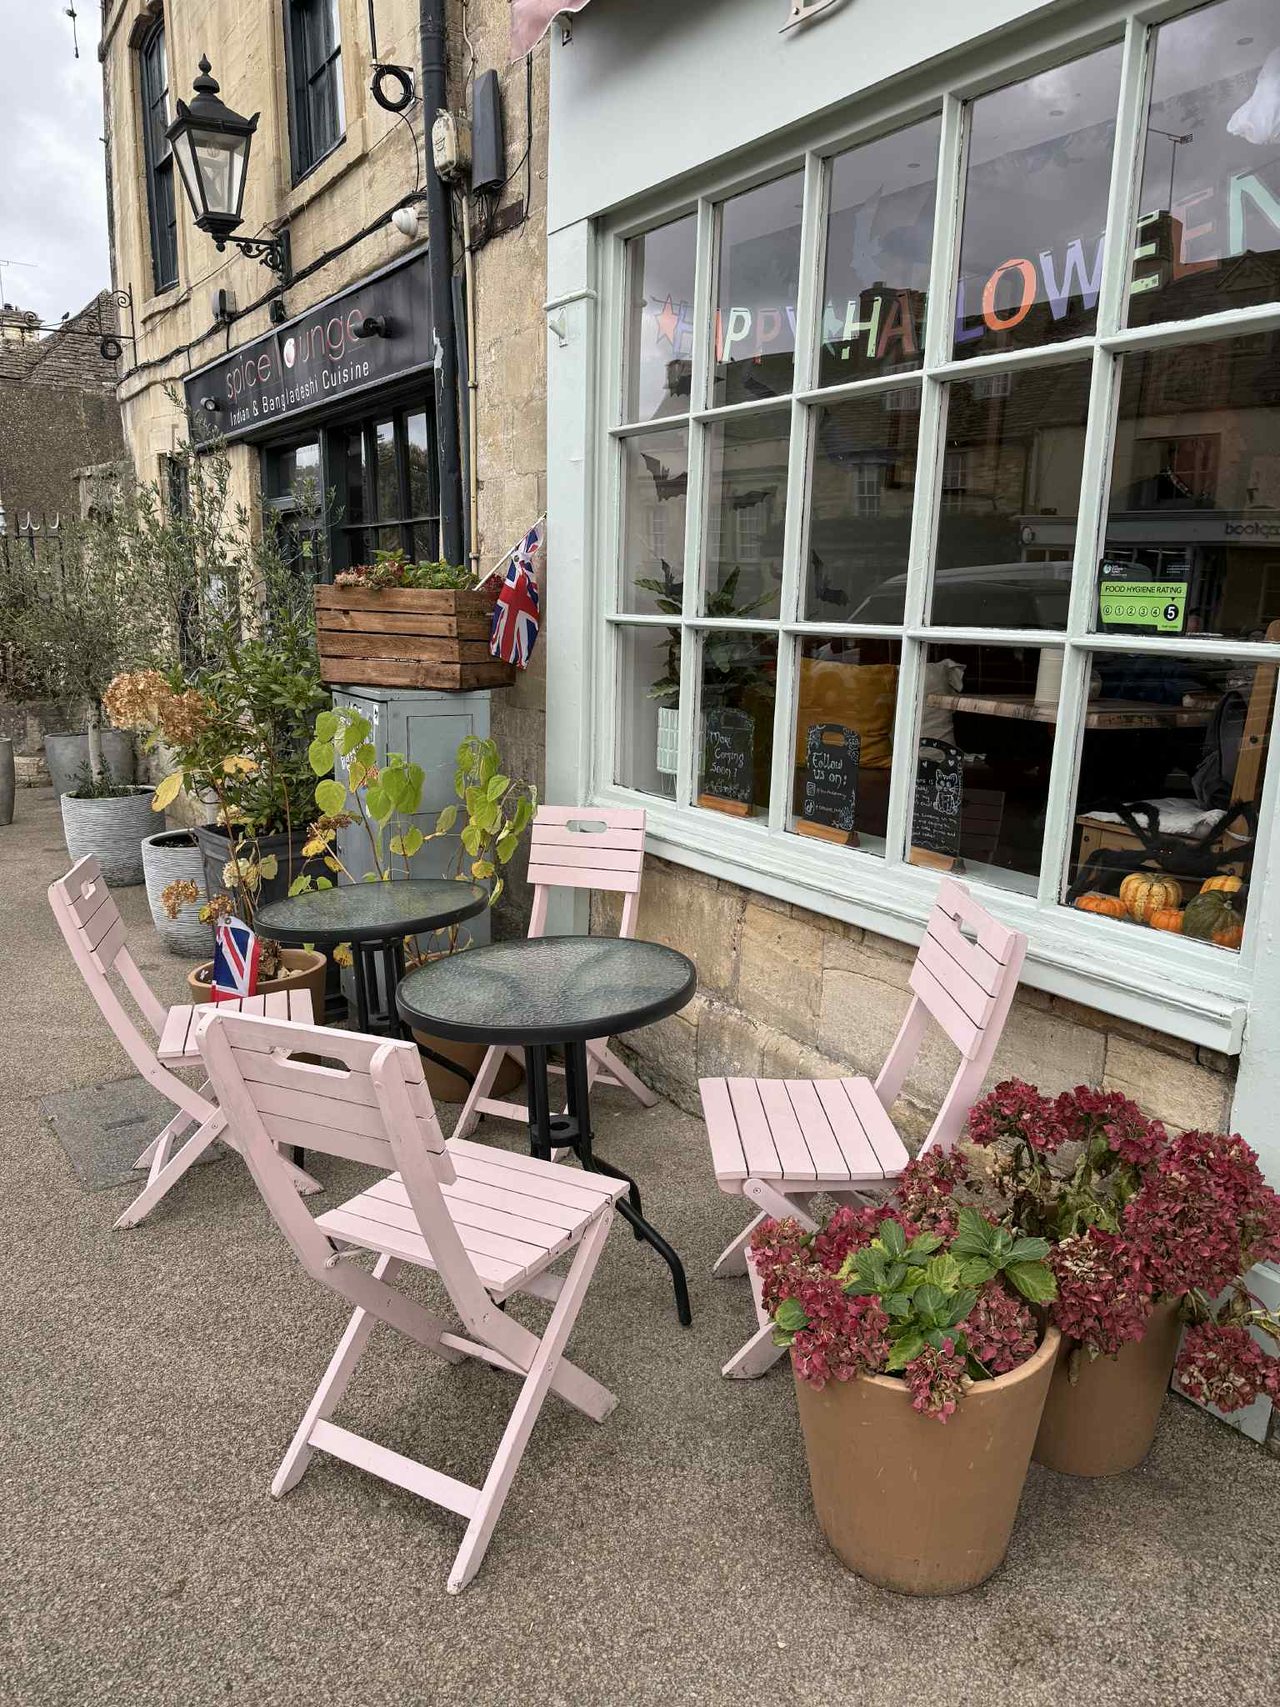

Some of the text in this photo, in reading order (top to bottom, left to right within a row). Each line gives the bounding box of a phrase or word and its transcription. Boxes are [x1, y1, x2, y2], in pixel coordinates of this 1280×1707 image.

[226, 354, 271, 403] spice
[230, 361, 369, 427] Indian & Bangladeshi Cuisine
[1105, 585, 1125, 593] FOOD
[812, 752, 843, 770] Follow
[813, 769, 825, 780] us
